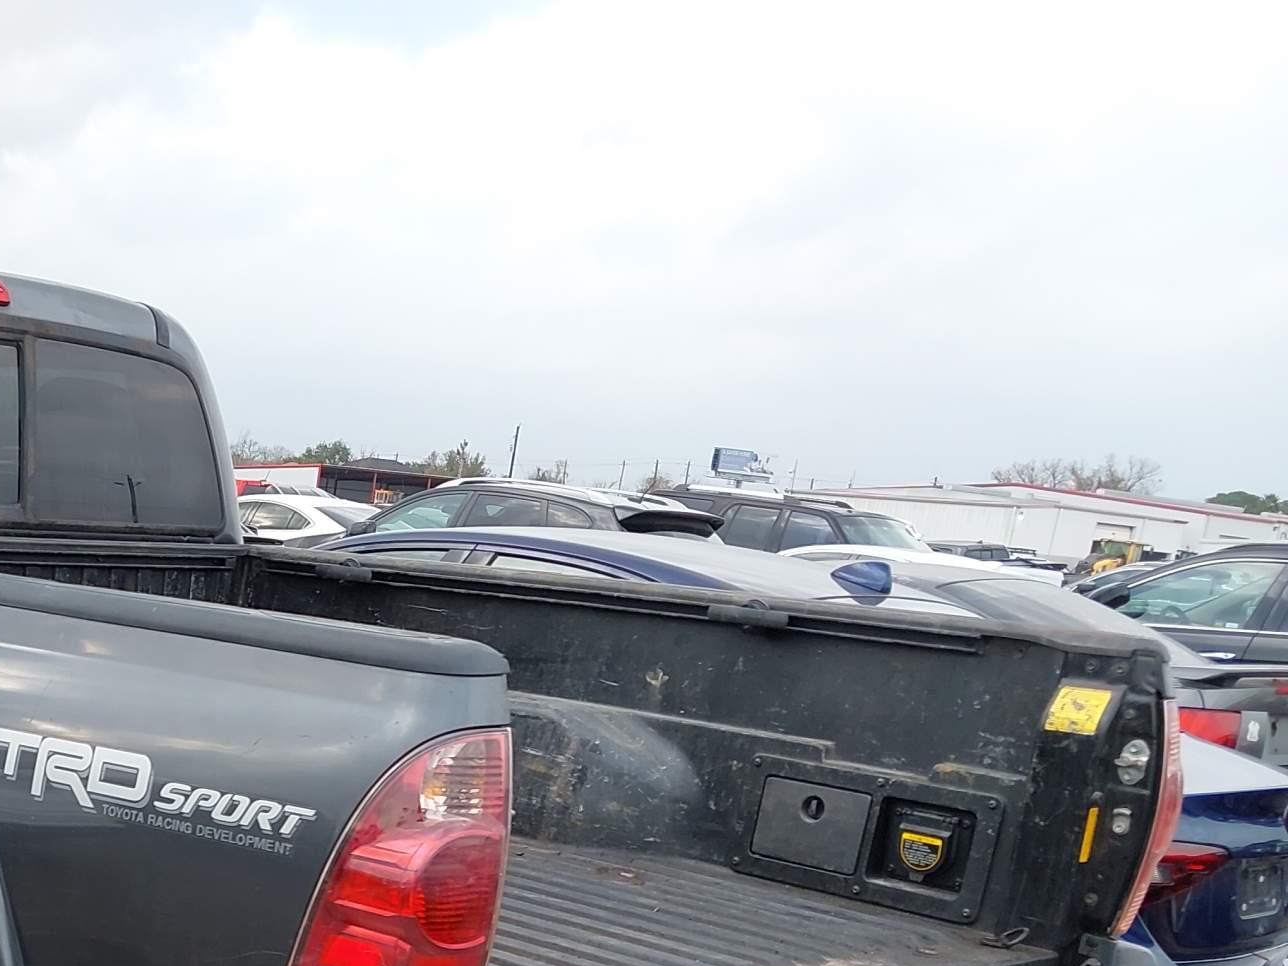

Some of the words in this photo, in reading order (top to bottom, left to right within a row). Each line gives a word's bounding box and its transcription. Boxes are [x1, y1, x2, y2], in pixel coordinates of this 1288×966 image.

[102, 804, 145, 824] TOYOTA
[147, 814, 193, 834] RACING
[195, 824, 294, 856] DEVELOPMENT
[153, 782, 317, 838] SPORT
